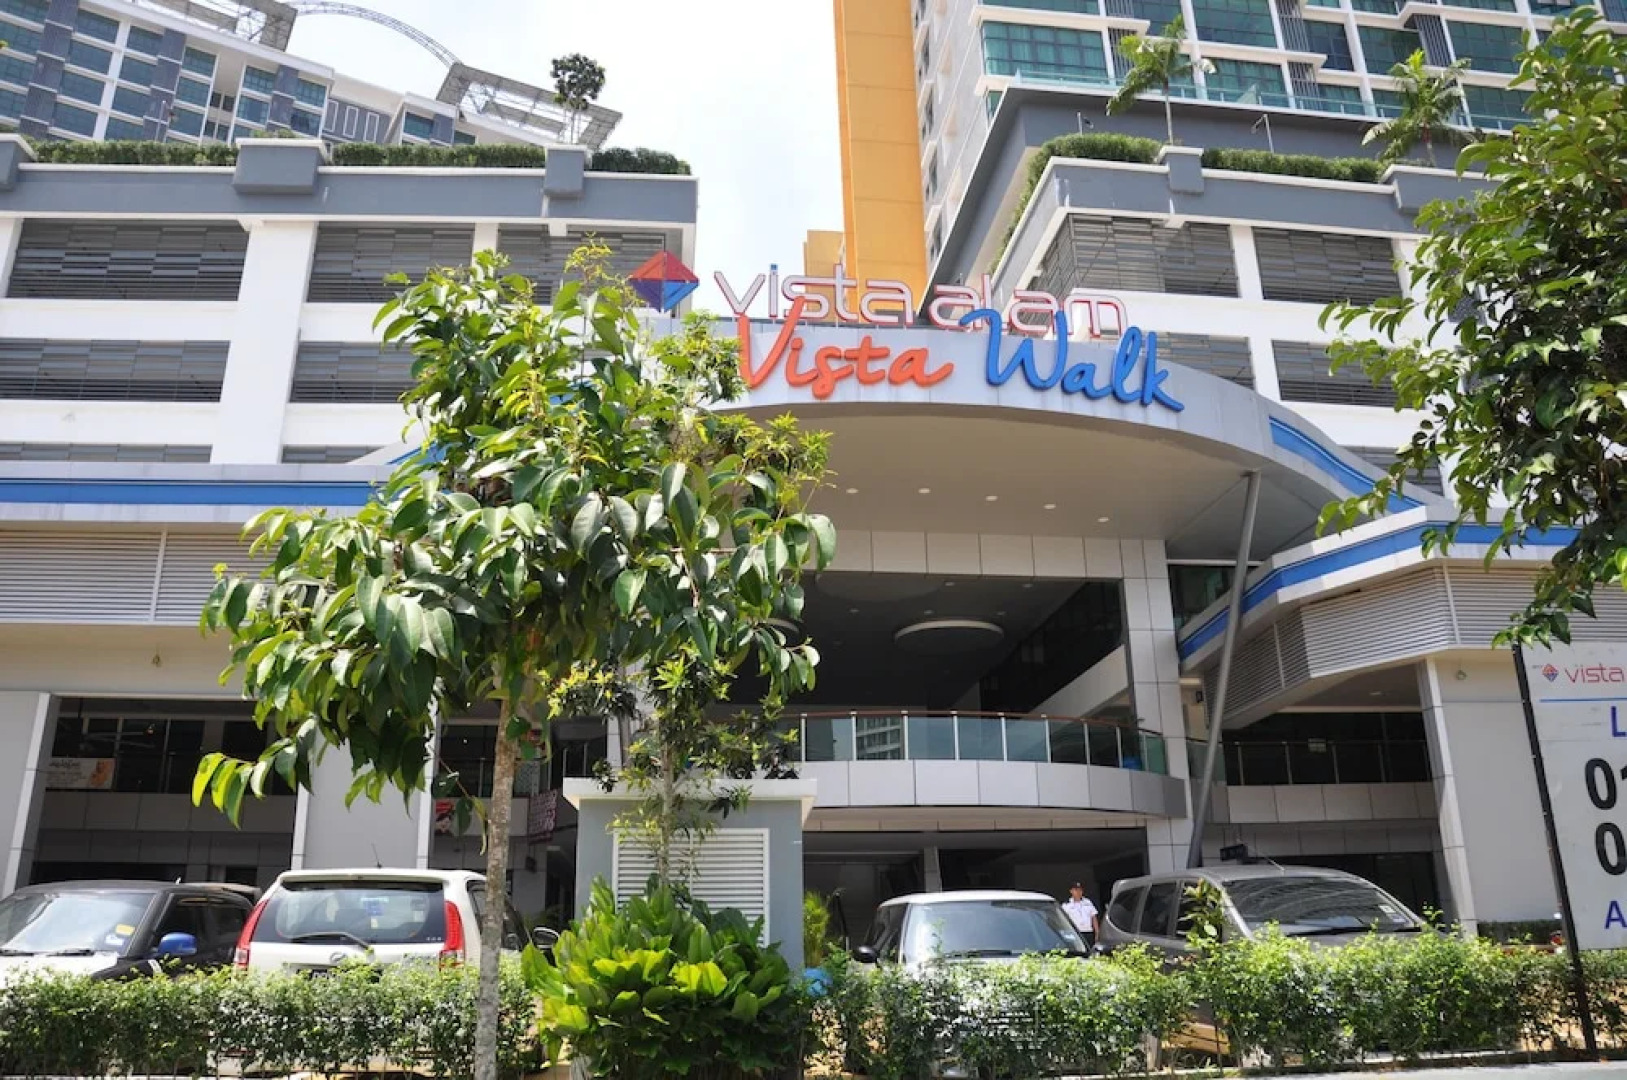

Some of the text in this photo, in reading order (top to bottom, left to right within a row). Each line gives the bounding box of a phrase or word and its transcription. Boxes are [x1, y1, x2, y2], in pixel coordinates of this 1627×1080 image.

[714, 263, 1128, 338] vista alam
[738, 296, 1185, 412] Vista Walk
[1564, 663, 1625, 683] vista
